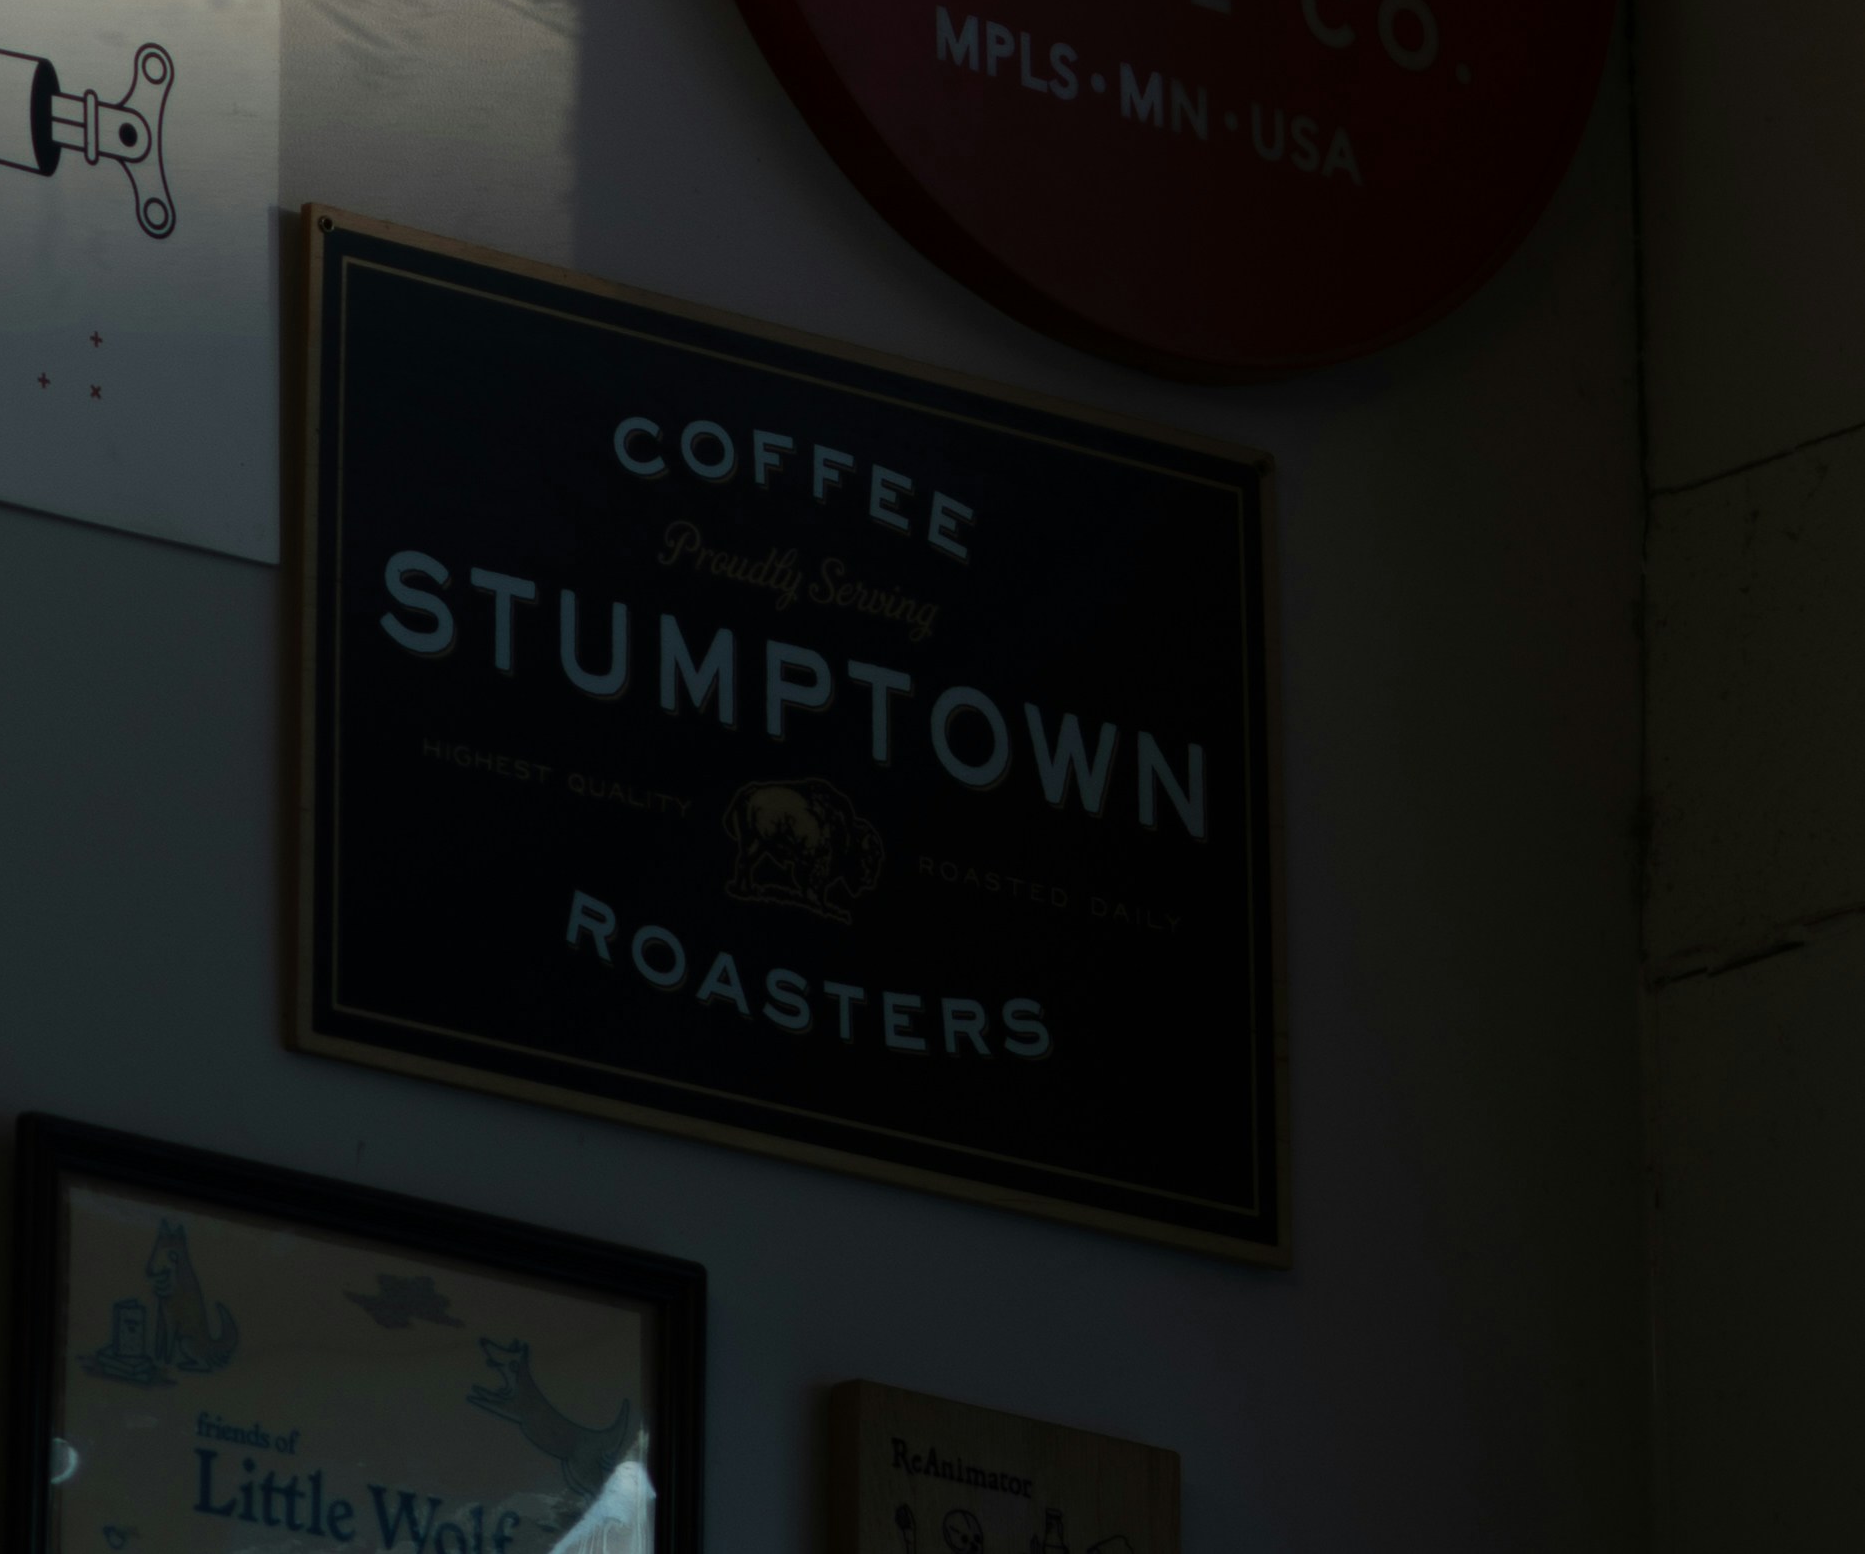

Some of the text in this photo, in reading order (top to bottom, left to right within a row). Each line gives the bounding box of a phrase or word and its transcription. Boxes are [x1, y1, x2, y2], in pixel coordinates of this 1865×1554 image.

[613, 416, 977, 565] COFFEE
[657, 520, 940, 643] Proudly Serving
[380, 548, 1210, 843] STUMPTOWN
[421, 737, 693, 818] HIGHEST QUALITY
[918, 853, 1183, 934] ROASTED DAILY
[565, 888, 1054, 1062] ROASTERS
[196, 1411, 301, 1455] friends of
[891, 1437, 1032, 1498] ReAnimator
[194, 1448, 357, 1542] Little
